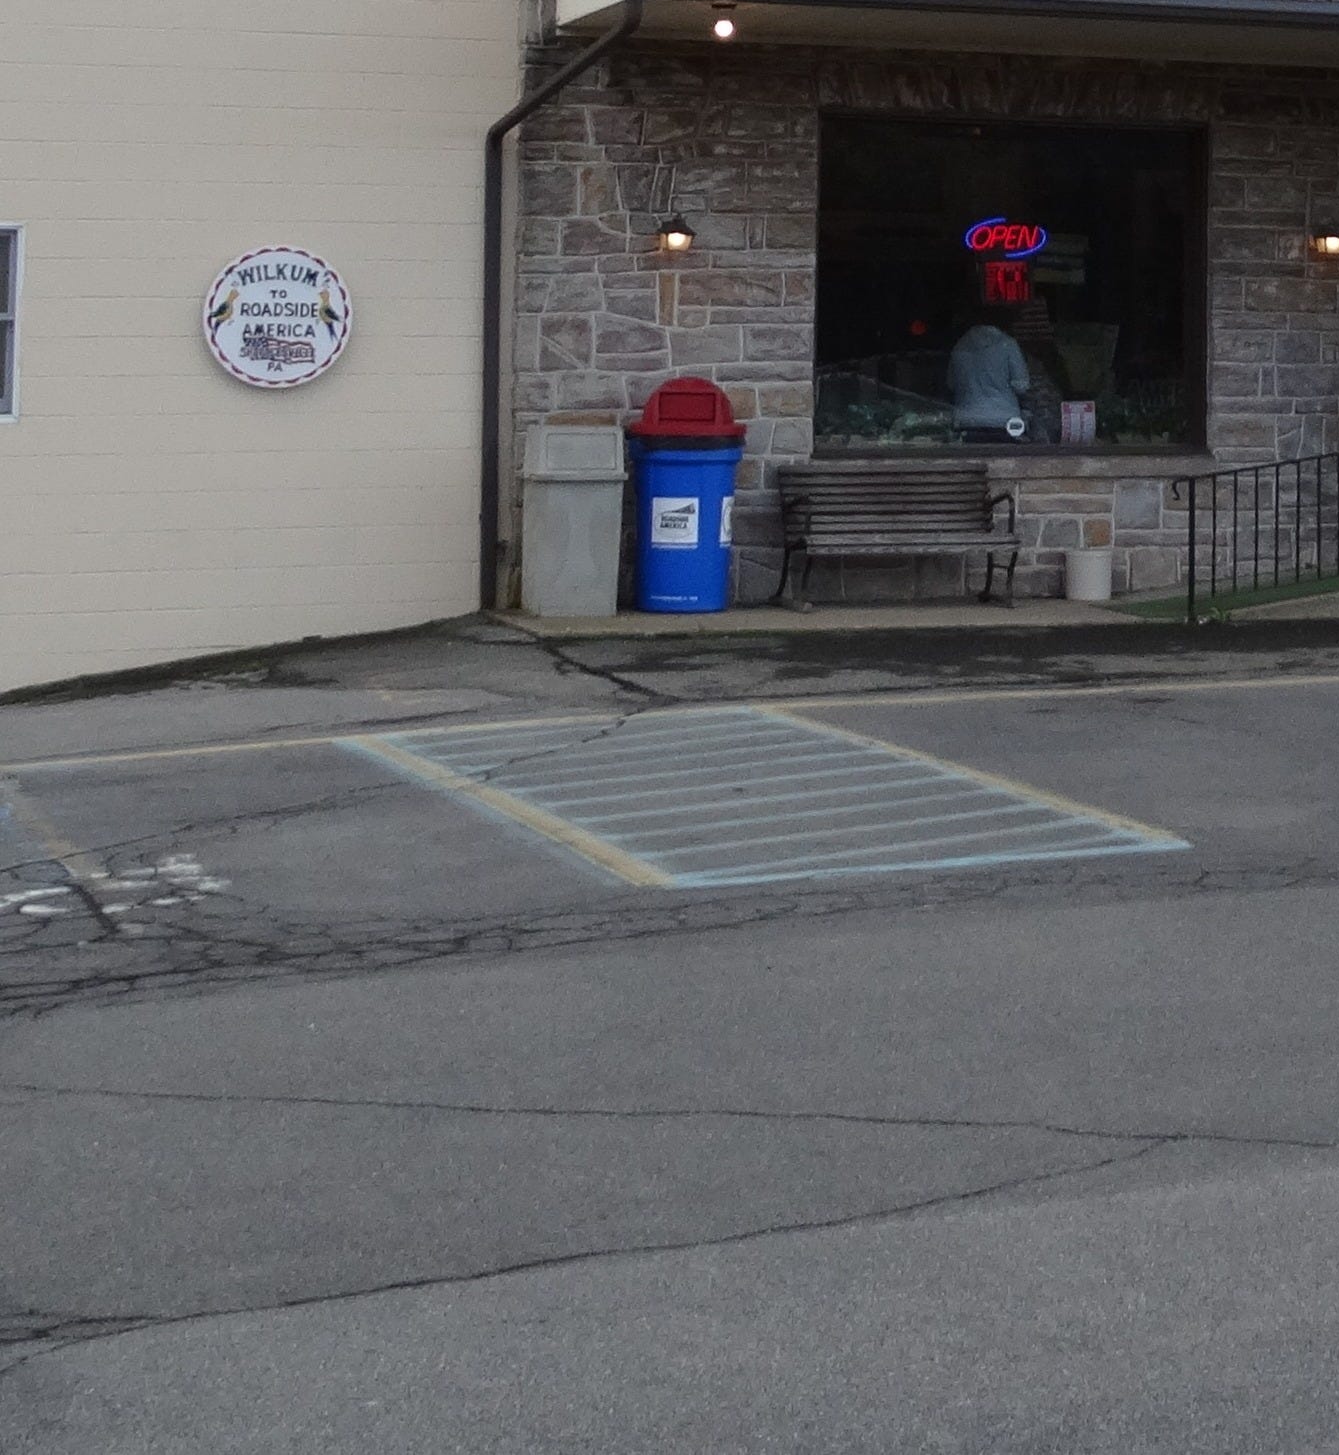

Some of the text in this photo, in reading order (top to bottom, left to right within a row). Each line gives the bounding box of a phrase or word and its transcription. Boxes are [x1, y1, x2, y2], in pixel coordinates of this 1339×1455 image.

[972, 225, 1039, 249] OPEN
[237, 263, 319, 287] WILKUM
[270, 289, 287, 299] TO
[240, 302, 319, 318] ROADSIDE
[242, 323, 316, 338] AMERICA
[267, 362, 283, 372] PA
